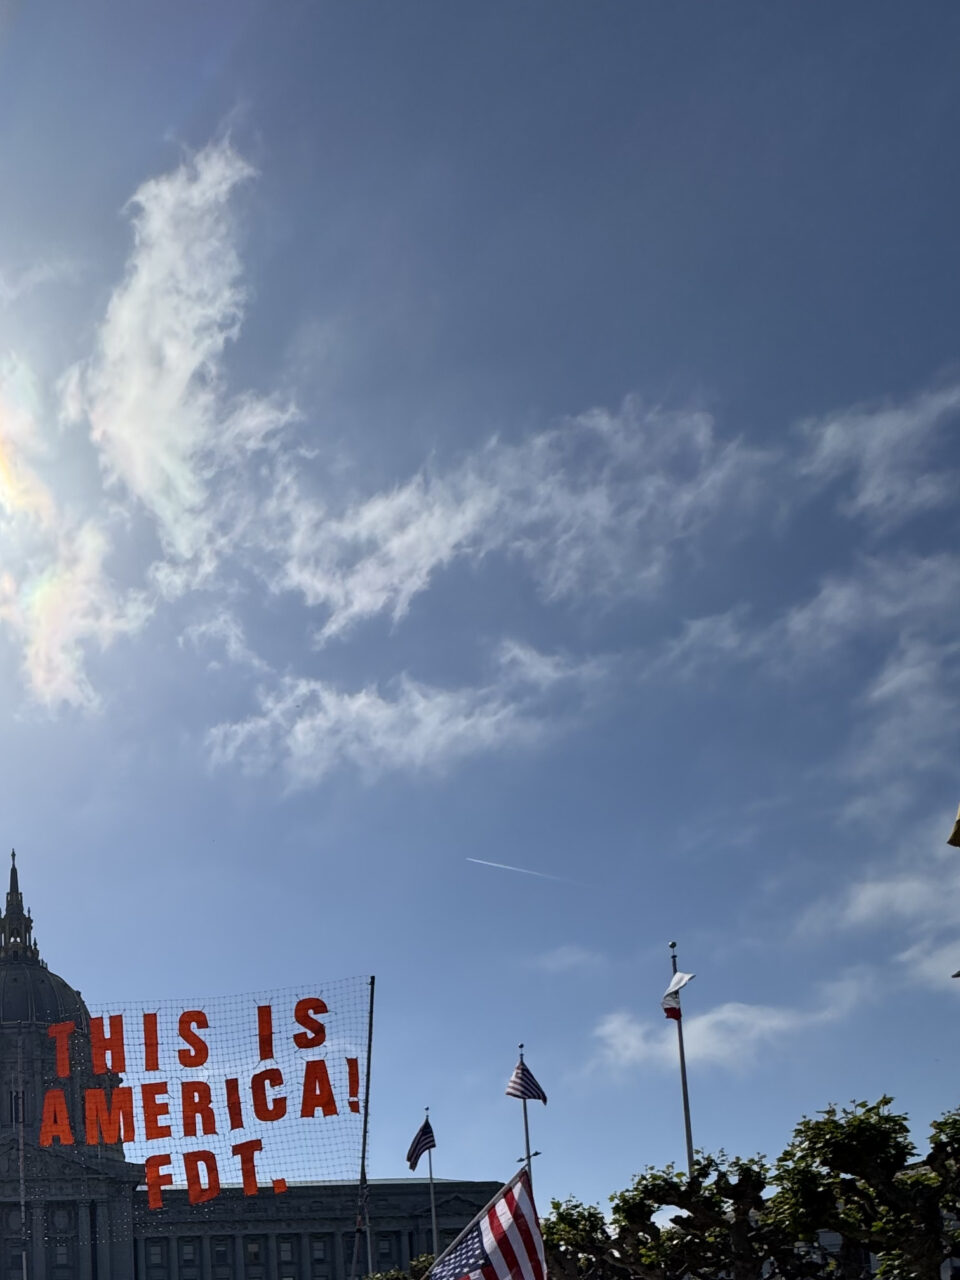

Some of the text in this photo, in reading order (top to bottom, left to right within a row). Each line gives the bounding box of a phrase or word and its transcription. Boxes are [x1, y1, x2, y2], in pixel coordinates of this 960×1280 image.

[47, 997, 328, 1078] THIS IS
[39, 1057, 360, 1147] AMERICA!
[145, 1139, 288, 1210] FDT.
